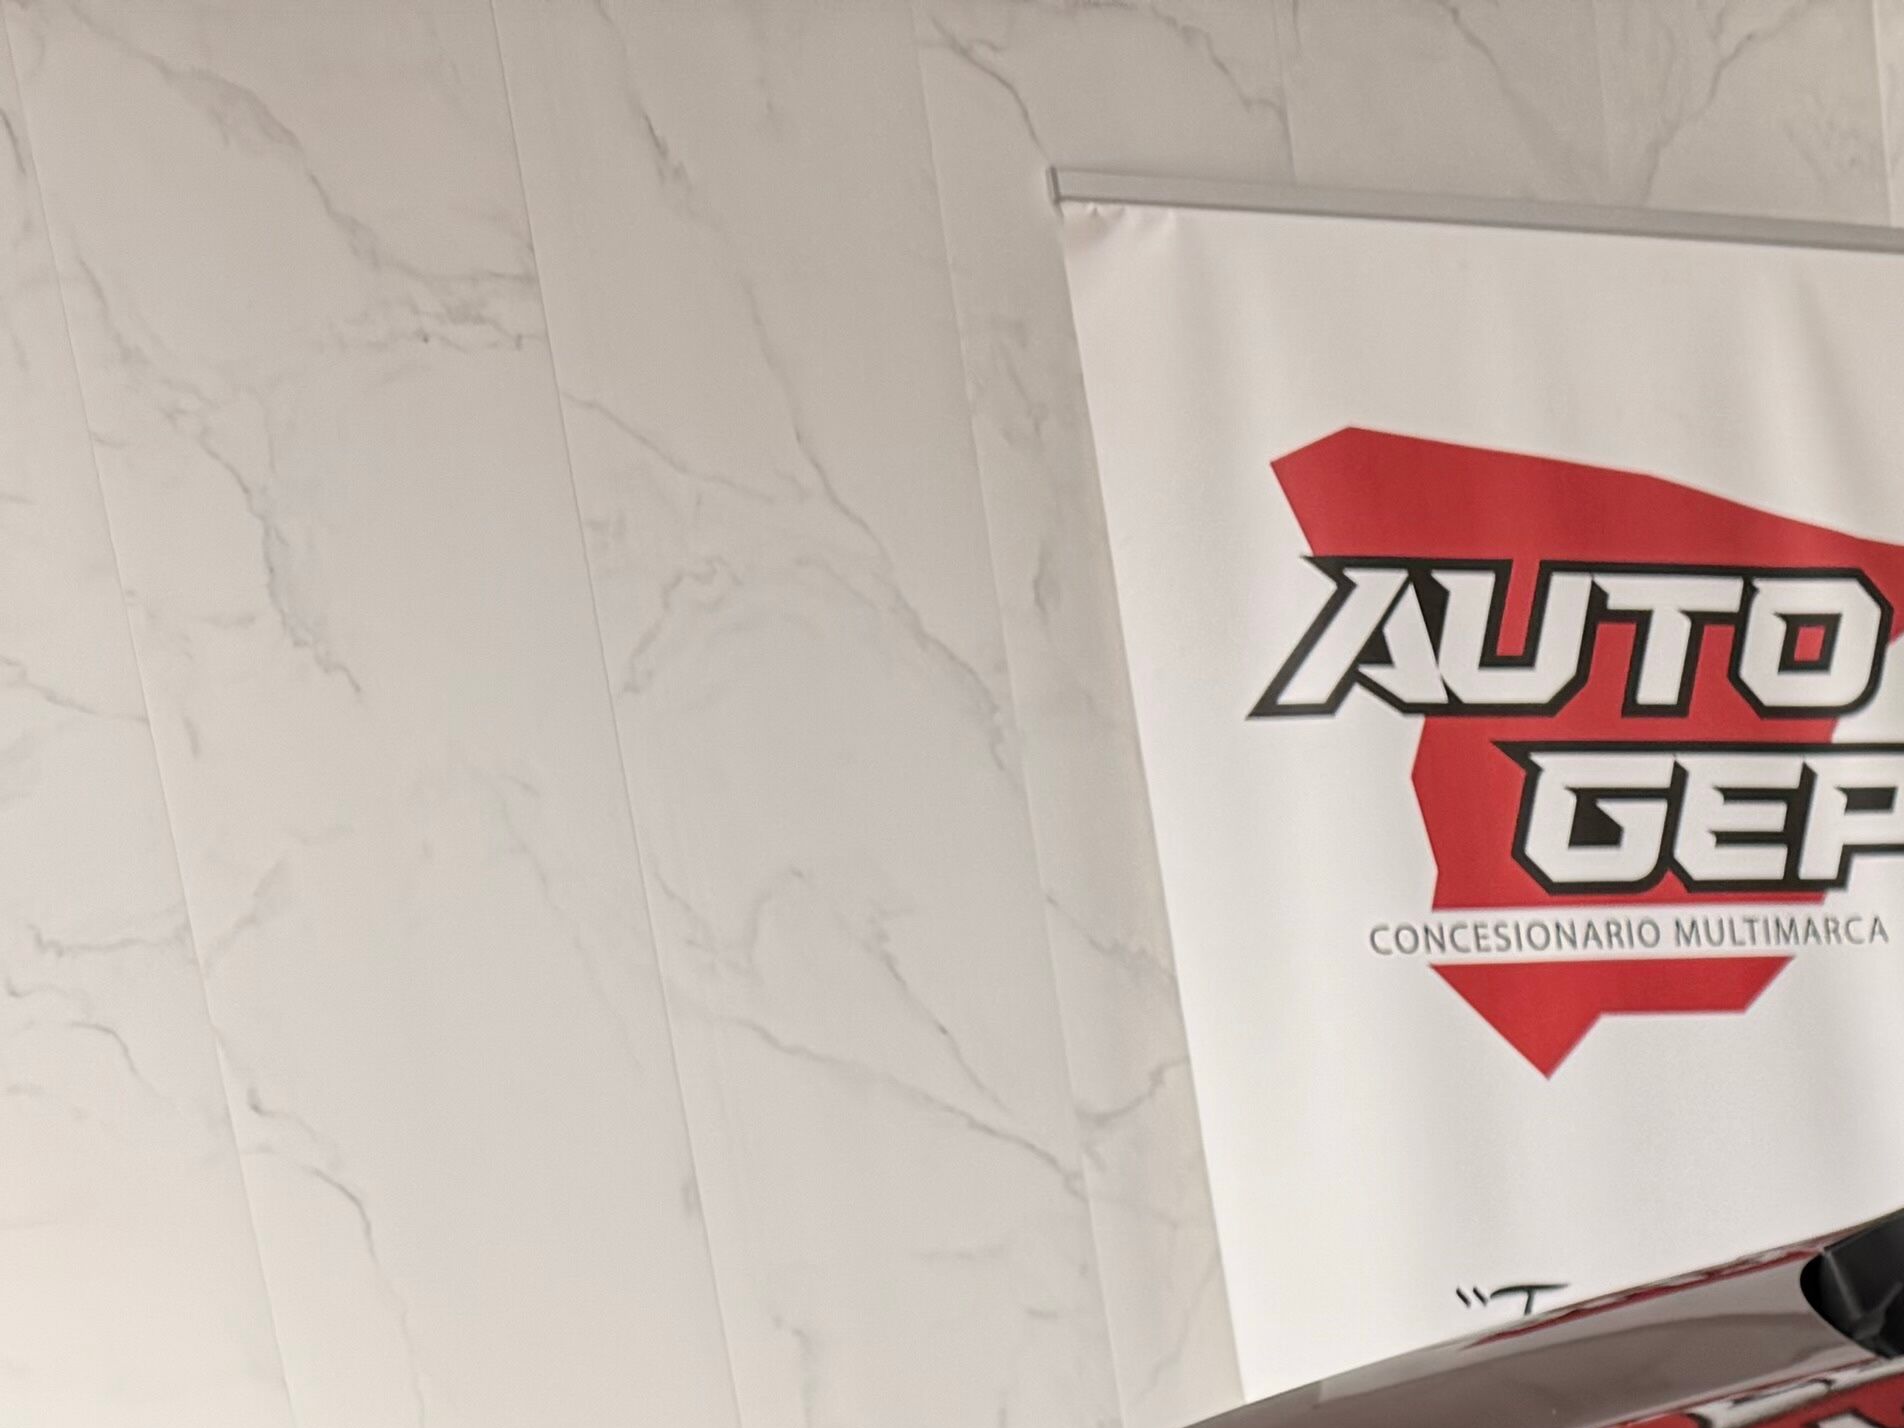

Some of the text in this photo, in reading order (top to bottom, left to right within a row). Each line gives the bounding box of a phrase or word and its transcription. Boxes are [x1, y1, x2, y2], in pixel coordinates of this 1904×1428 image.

[1247, 555, 1895, 719] AUTO
[1368, 914, 1890, 956] CONCESIONARIO MULTIMARCA
